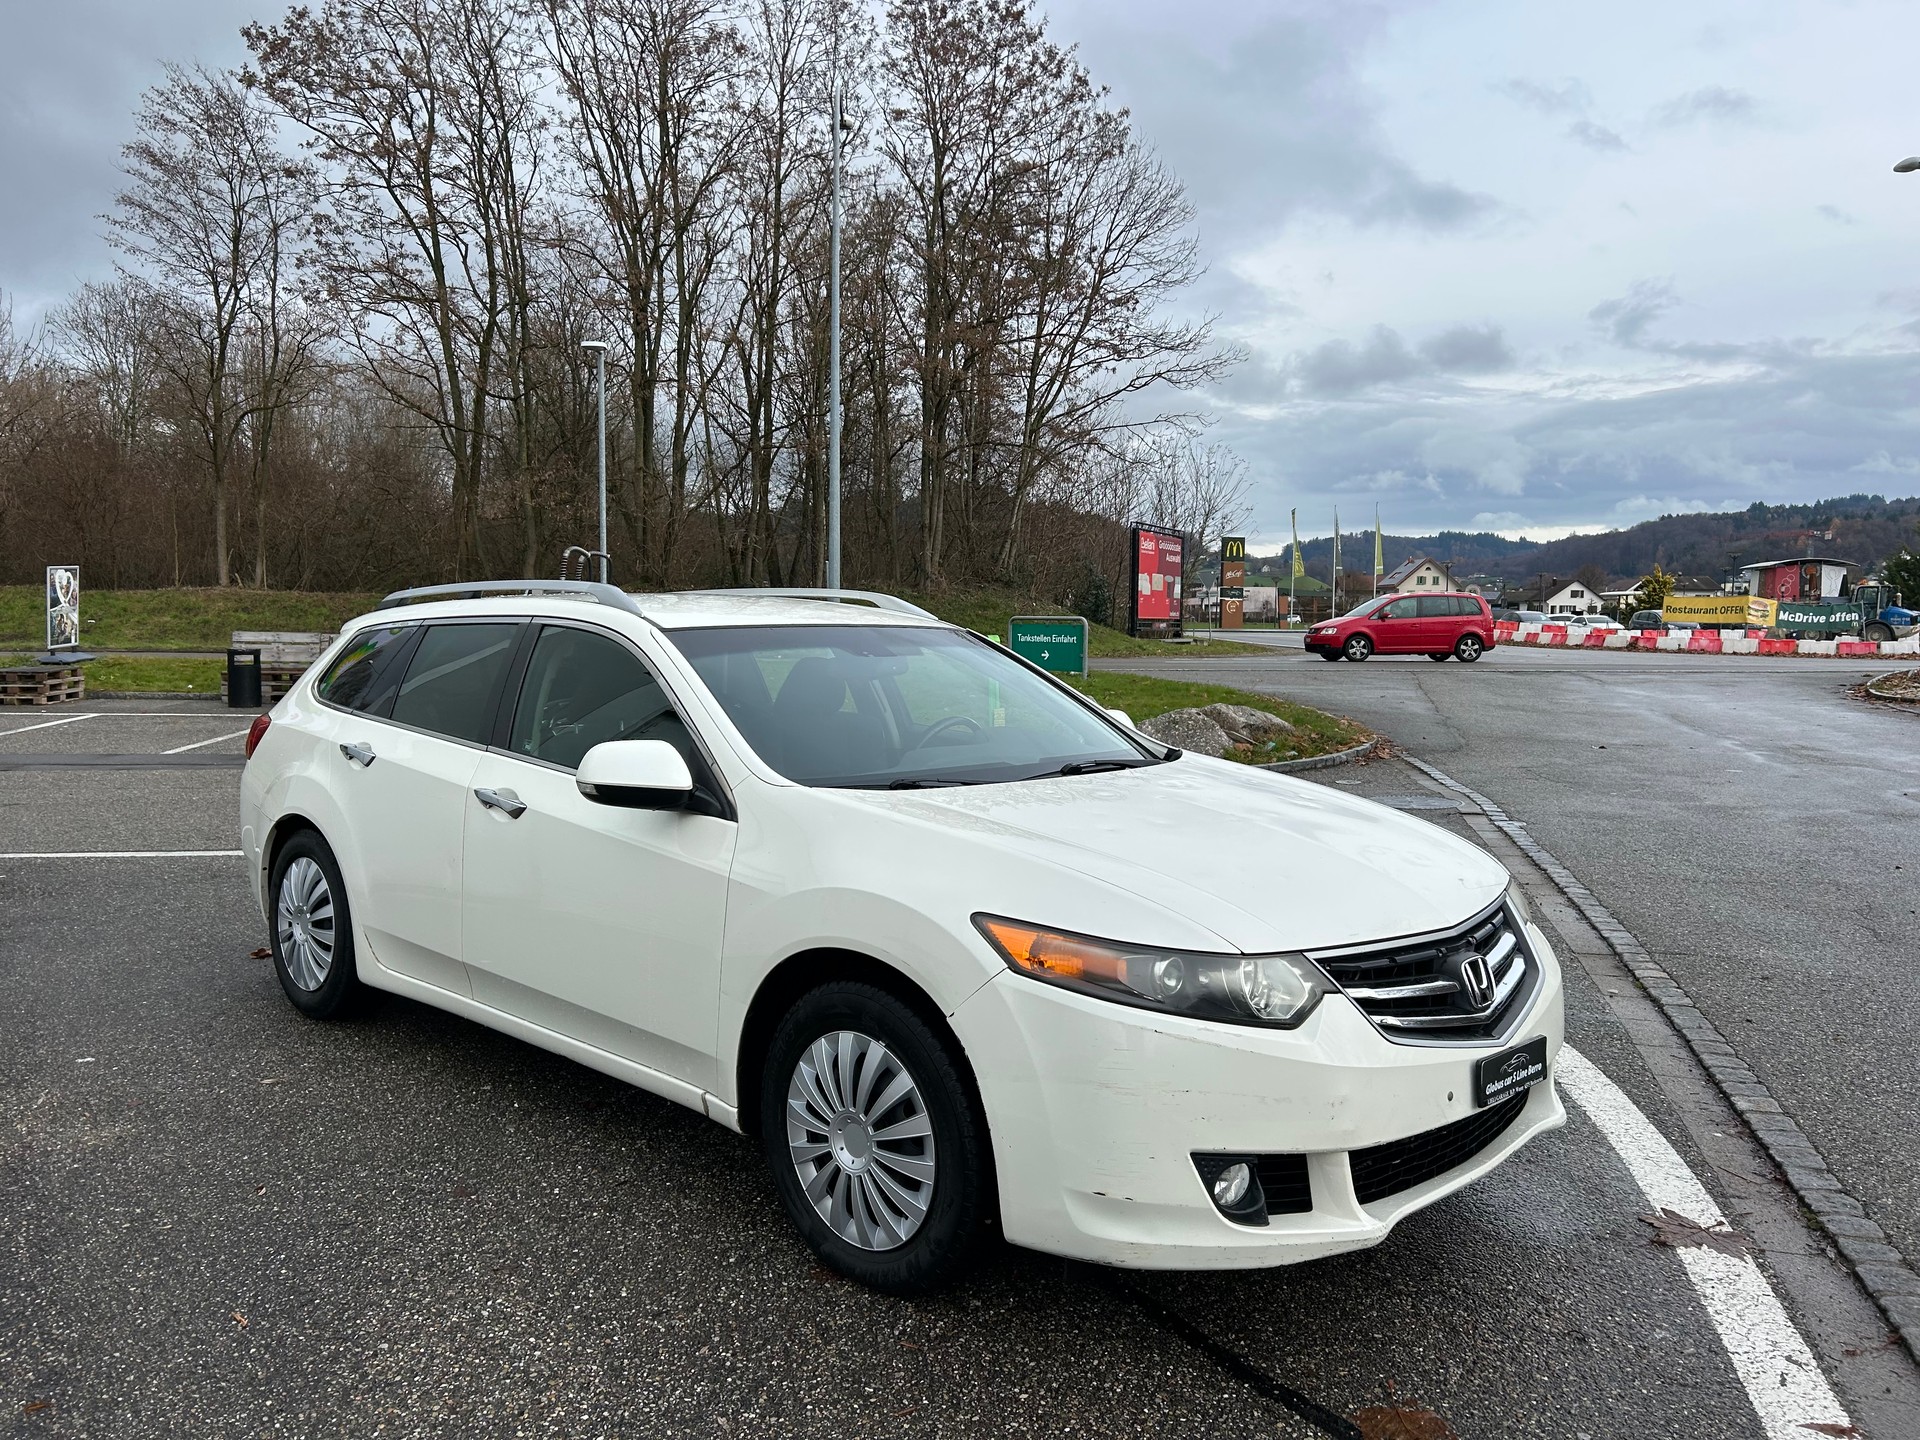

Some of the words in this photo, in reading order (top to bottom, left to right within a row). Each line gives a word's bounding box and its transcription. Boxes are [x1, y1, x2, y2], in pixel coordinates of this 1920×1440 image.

[1665, 605, 1718, 615] Restaurant
[1719, 605, 1744, 615] OFFEN
[1778, 610, 1827, 623] McDrive
[1829, 612, 1859, 622] offen
[1017, 633, 1051, 643] Tankstellen
[1052, 634, 1077, 644] Einfahrt
[1486, 1079, 1504, 1095] Globus
[1512, 1071, 1517, 1083] S
[1517, 1068, 1528, 1081] Line
